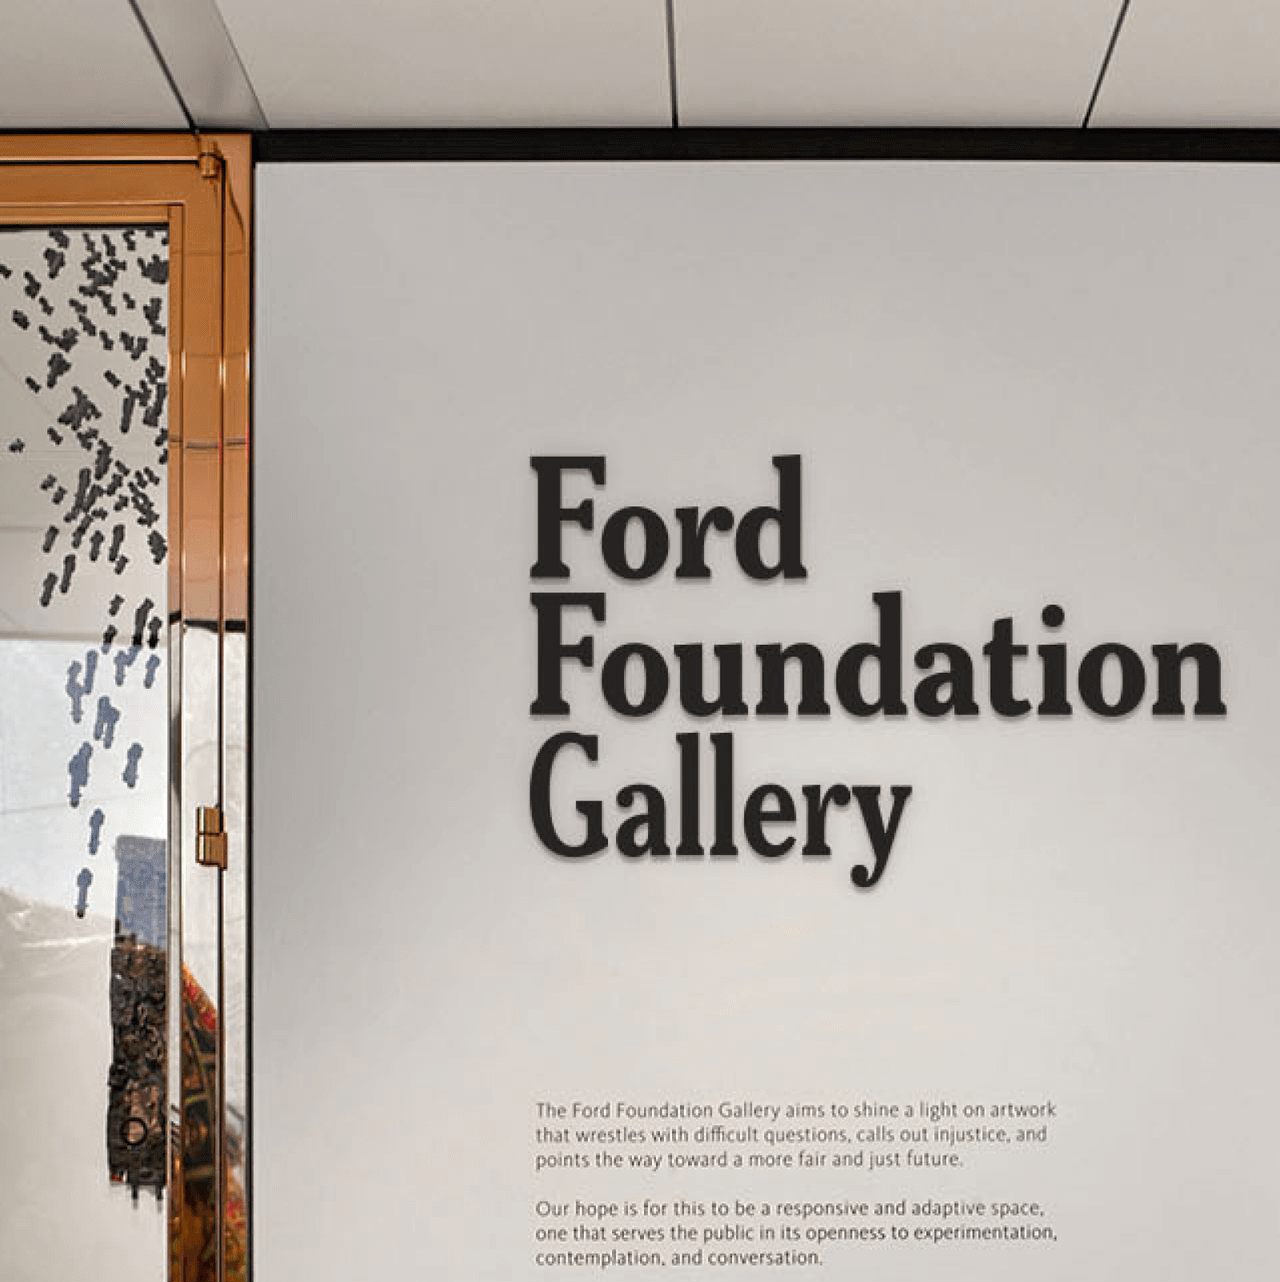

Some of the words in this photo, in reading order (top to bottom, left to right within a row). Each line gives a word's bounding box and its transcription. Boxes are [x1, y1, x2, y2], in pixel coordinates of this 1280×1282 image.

[529, 454, 808, 582] Ford
[529, 590, 1228, 718] Foundation
[529, 731, 913, 888] Gallery
[535, 1102, 567, 1119] The
[572, 1102, 611, 1119] Ford
[616, 1101, 713, 1120] Foundation
[717, 1101, 781, 1123] Gallery
[785, 1103, 826, 1118] aims
[831, 1104, 849, 1119] to
[853, 1100, 900, 1119] shine
[903, 1104, 915, 1118] a
[919, 1100, 958, 1123] light
[962, 1104, 985, 1118] on
[989, 1100, 1057, 1118] artwork
[535, 1126, 570, 1144] that
[575, 1126, 647, 1144] wrestles
[651, 1125, 689, 1144] with
[693, 1124, 759, 1144] difficult
[763, 1127, 852, 1146] questions,
[855, 1125, 895, 1143] calls
[899, 1128, 929, 1142] out
[934, 1126, 1011, 1147] injustice,
[1015, 1125, 1047, 1142] and
[535, 1151, 591, 1172] points
[595, 1150, 624, 1168] the
[627, 1154, 663, 1172] way
[667, 1150, 728, 1168] toward
[733, 1154, 743, 1168] a
[749, 1154, 793, 1168] more
[798, 1149, 827, 1168] fair
[831, 1150, 864, 1168] and
[869, 1150, 901, 1171] just
[906, 1148, 963, 1168] future.
[535, 1200, 569, 1218] Our
[575, 1200, 619, 1220] hope
[623, 1201, 639, 1217] is
[643, 1198, 667, 1217] for
[673, 1200, 706, 1217] this
[711, 1202, 730, 1217] to
[735, 1199, 757, 1217] be
[760, 1203, 771, 1216] a
[775, 1201, 869, 1220] responsive
[873, 1199, 907, 1216] and
[911, 1198, 986, 1220] adaptive
[990, 1202, 1045, 1220] space,
[535, 1228, 569, 1242] one
[572, 1224, 607, 1242] that
[611, 1227, 665, 1242] serves
[669, 1223, 699, 1242] the
[703, 1224, 754, 1245] public
[759, 1225, 775, 1241] in
[780, 1224, 801, 1242] its
[805, 1227, 887, 1245] openness
[891, 1225, 910, 1241] to
[913, 1224, 1058, 1244] experimentation,
[535, 1248, 667, 1270] contemplation,
[671, 1248, 703, 1266] and
[707, 1249, 823, 1266] conversation.
